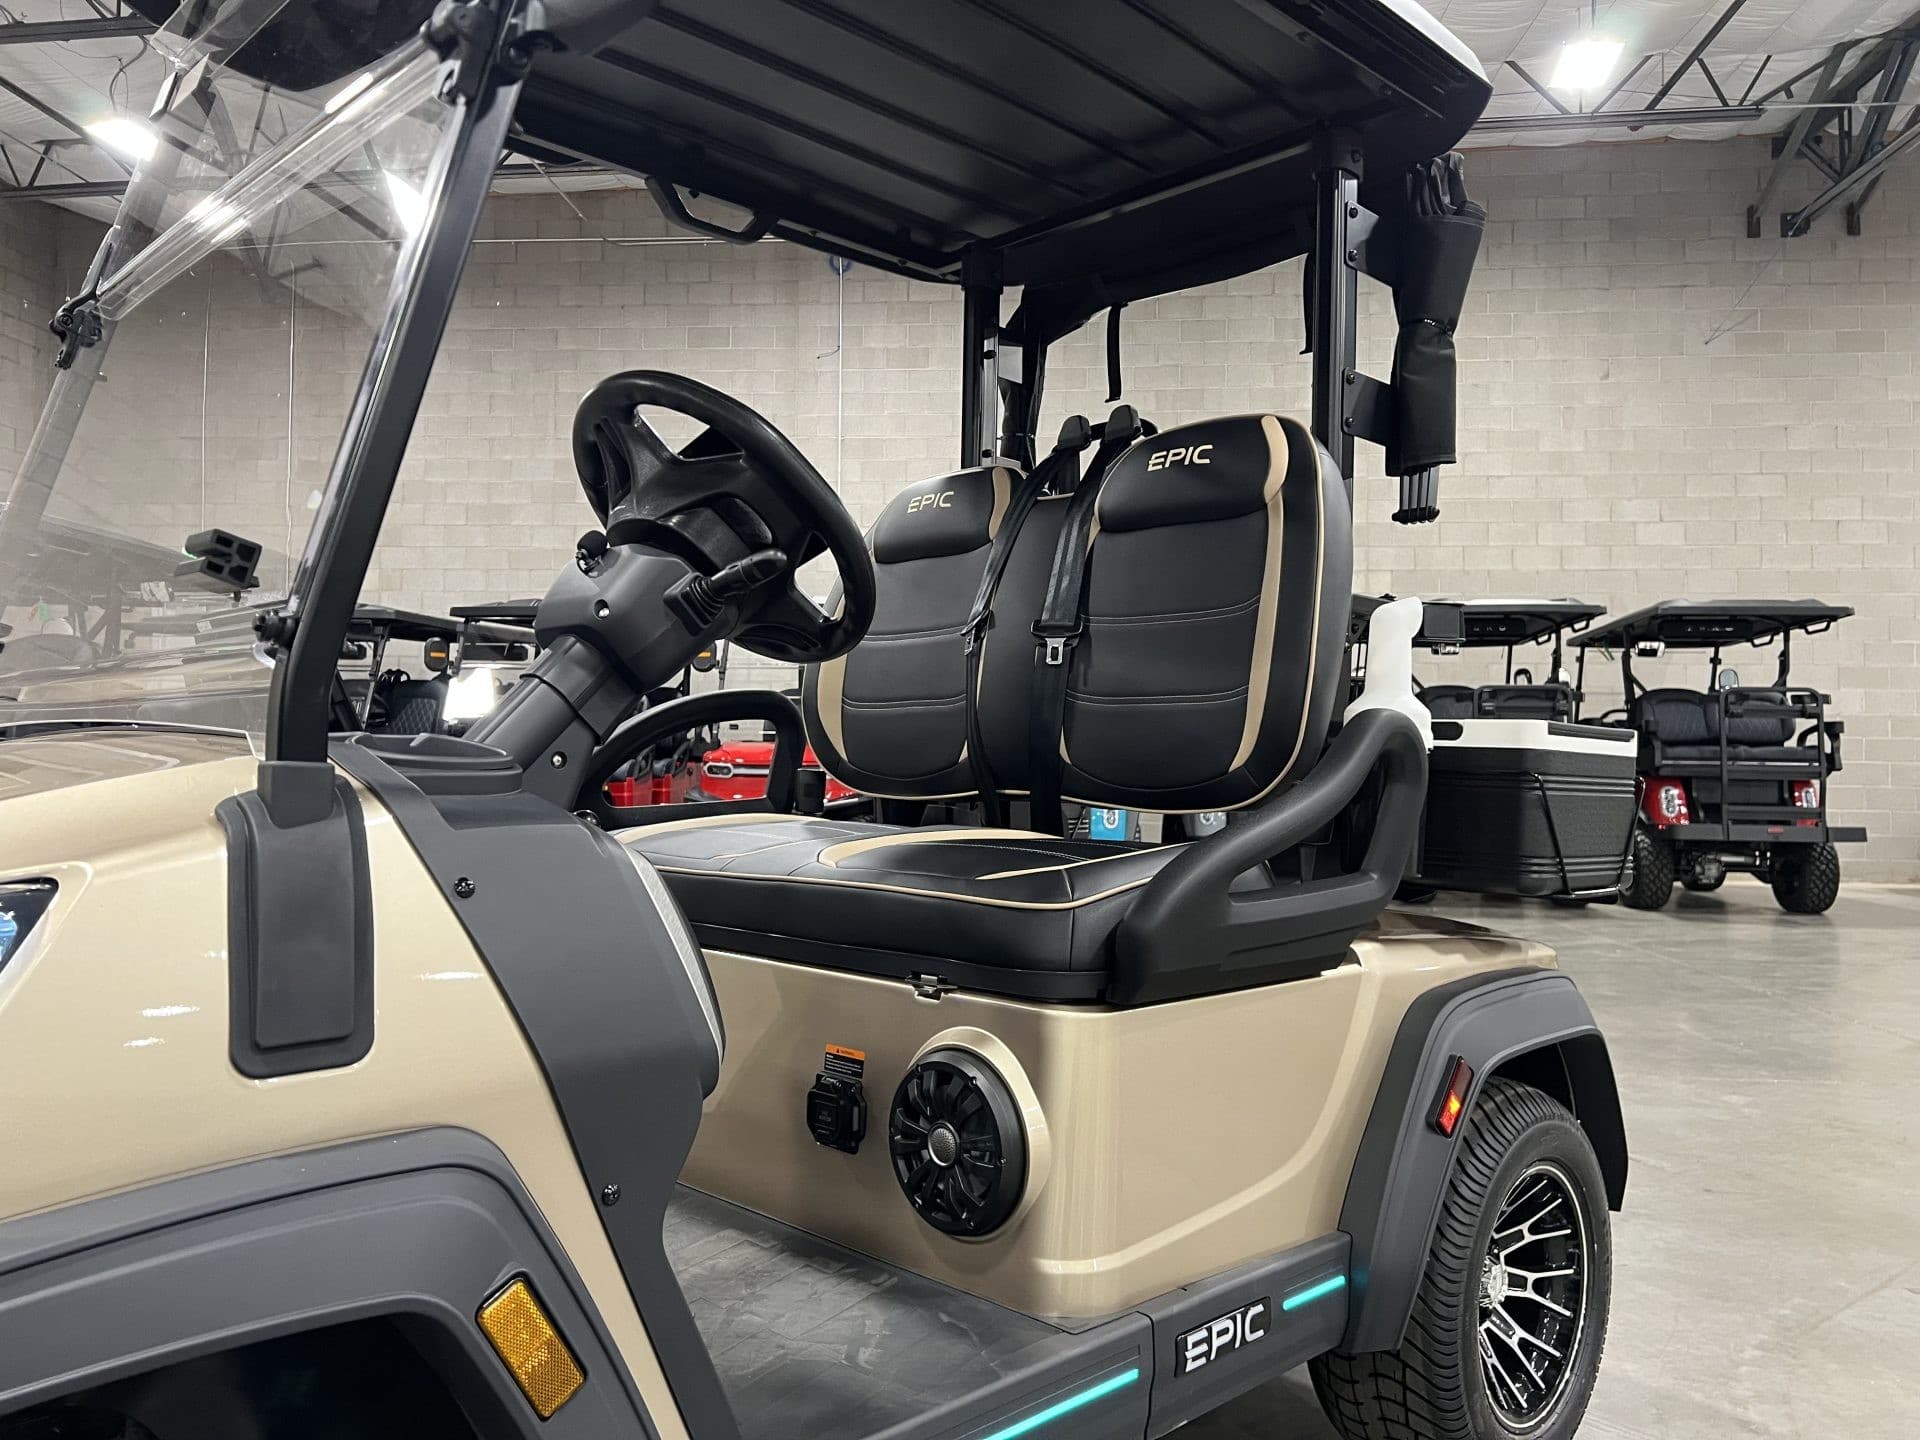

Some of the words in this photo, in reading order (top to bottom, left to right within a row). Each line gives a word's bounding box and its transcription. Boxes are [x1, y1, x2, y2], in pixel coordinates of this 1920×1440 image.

[1147, 444, 1213, 472] EPIC
[907, 491, 954, 514] EPIC
[1185, 1303, 1265, 1373] EPIC
